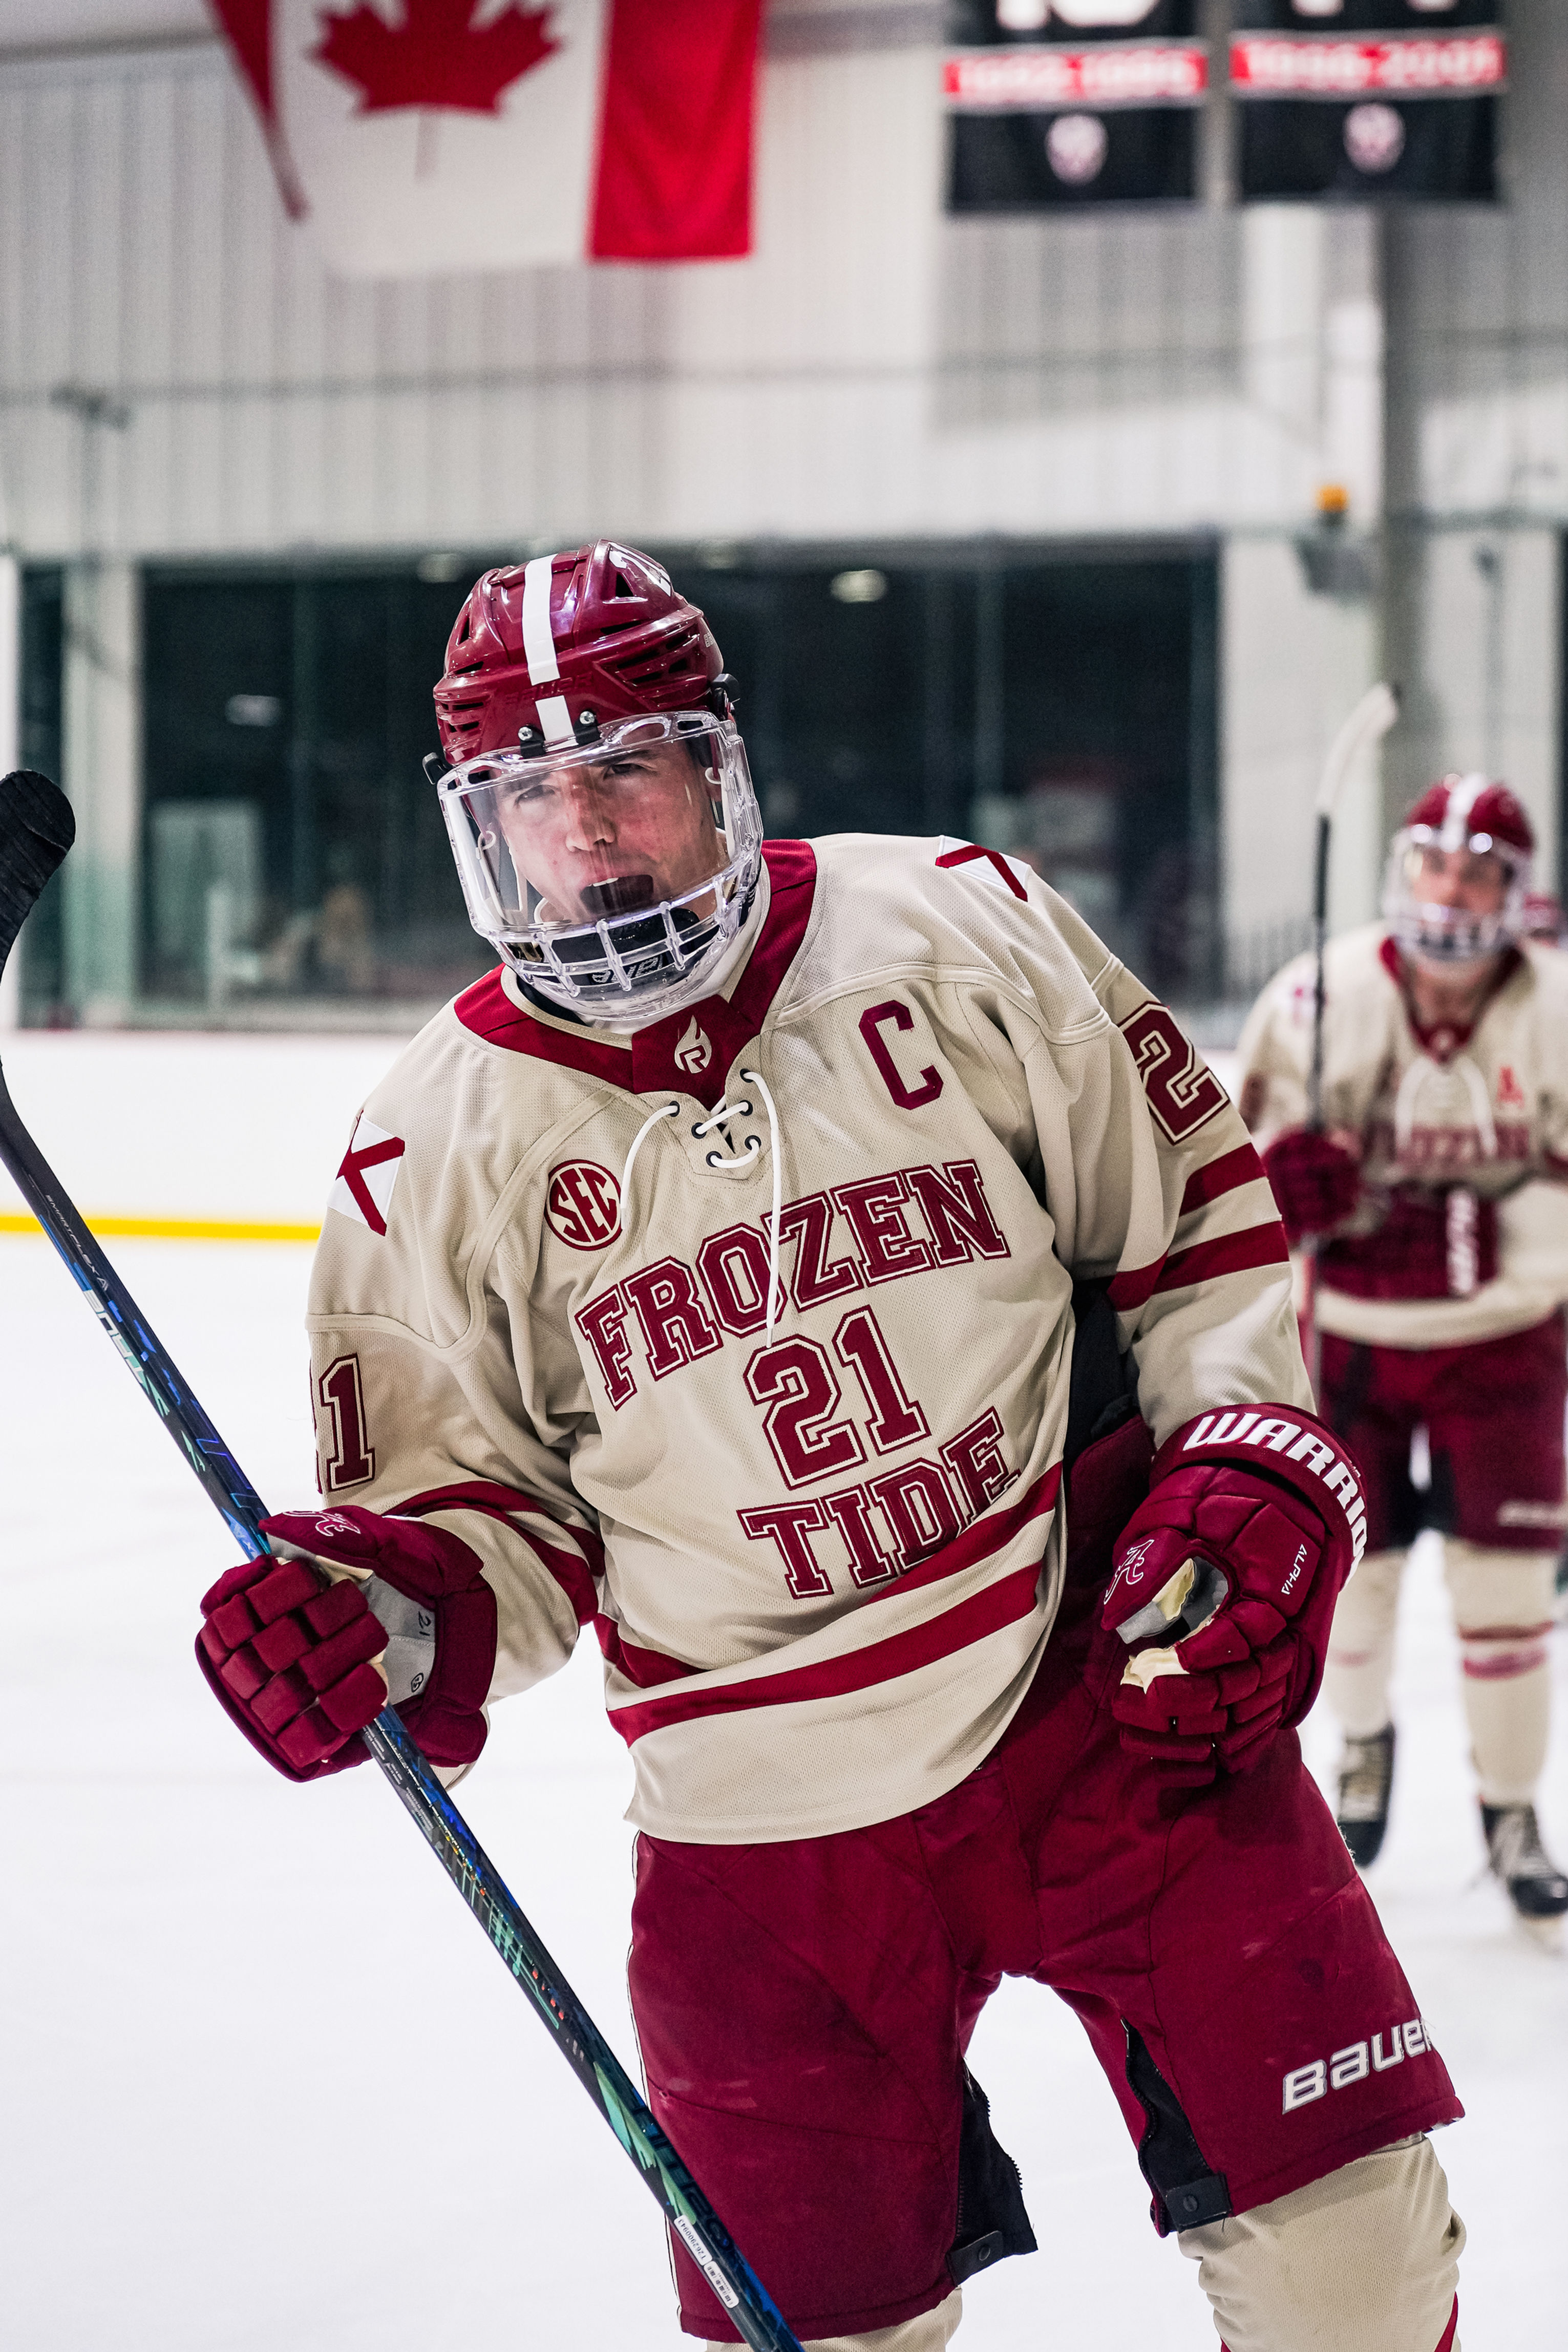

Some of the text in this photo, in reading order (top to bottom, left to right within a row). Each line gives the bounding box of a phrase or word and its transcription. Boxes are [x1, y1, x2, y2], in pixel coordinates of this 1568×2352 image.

[859, 1000, 943, 1110] C
[549, 1167, 618, 1243] SEC
[574, 1158, 1011, 1412] FROZEN
[309, 1352, 375, 1494] 1
[742, 1304, 932, 1491] 21
[736, 1406, 1022, 1600] TIDE
[418, 1611, 432, 1636] 21
[1281, 1543, 1307, 1595] ALPHA
